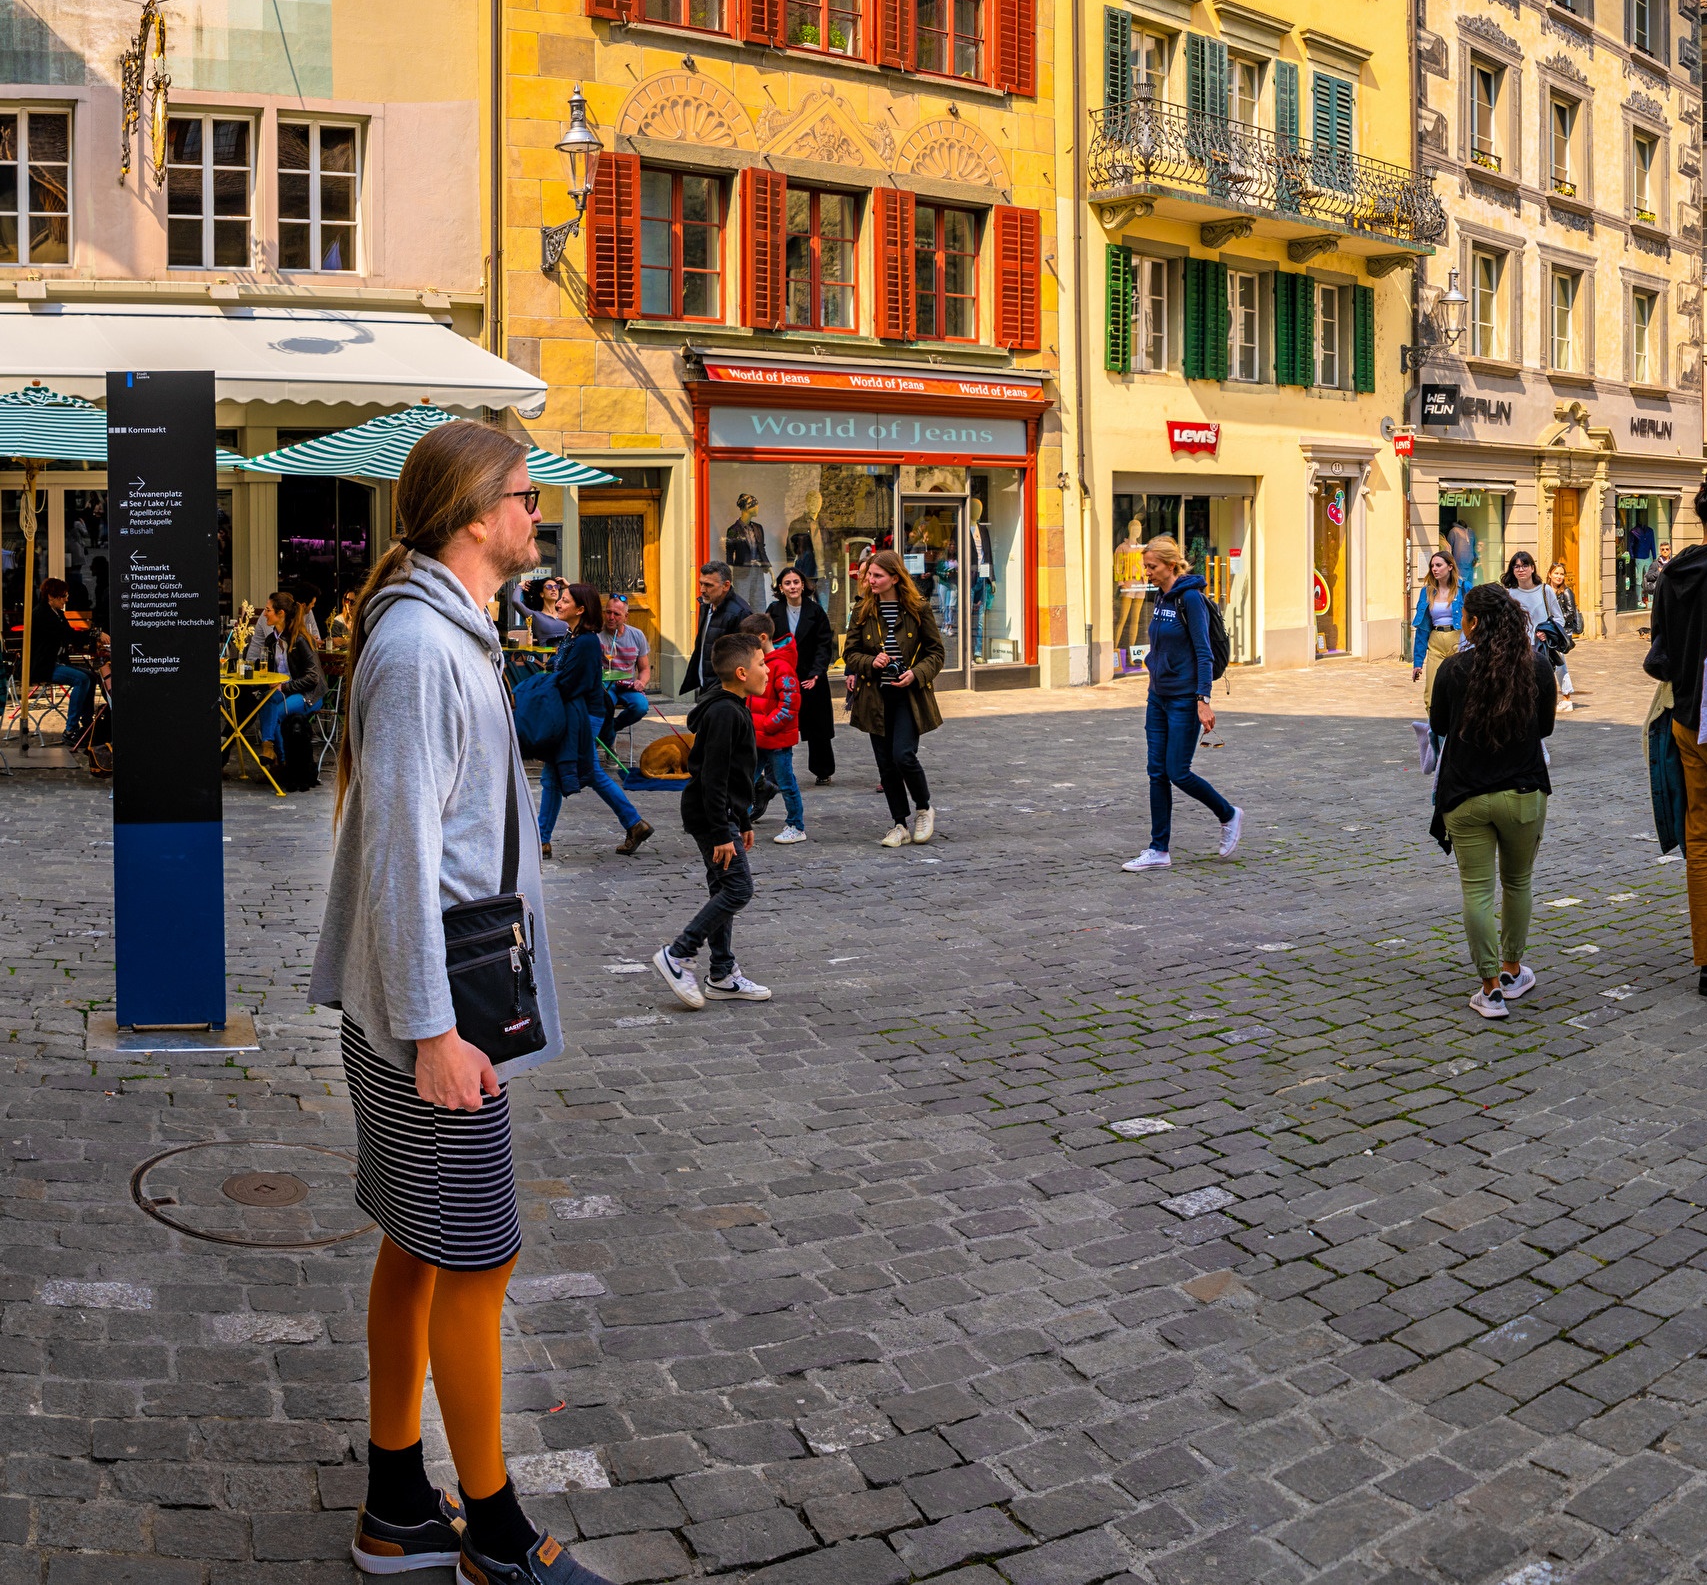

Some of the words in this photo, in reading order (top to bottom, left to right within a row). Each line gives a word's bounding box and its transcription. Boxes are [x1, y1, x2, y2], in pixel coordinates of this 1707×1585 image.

[728, 368, 764, 382] World
[766, 372, 779, 384] of
[780, 371, 811, 385] Jeans
[849, 375, 884, 389] World
[885, 378, 897, 390] of
[897, 378, 925, 391] Jeans
[958, 383, 991, 396] World
[991, 385, 1002, 397] of
[1002, 385, 1029, 398] Jeans
[128, 426, 167, 434] Kornmarkt
[750, 414, 857, 439] World
[868, 420, 902, 440] of
[910, 421, 994, 446] Jeans
[128, 490, 182, 498] Schwanenplatz
[129, 509, 172, 518] Kapellbrücke
[129, 518, 173, 527] Peterskapelle
[130, 564, 170, 572] Weinmarkt
[130, 573, 176, 582] Theaterplatz
[159, 582, 183, 590] Gütsch
[170, 591, 199, 599] Museum
[130, 601, 177, 609] Naturmuseum
[131, 610, 178, 619] Spreuerbrücke
[131, 620, 176, 628] Pädagogische
[177, 618, 215, 626] Hochschule
[132, 657, 180, 665] Hirschenplatz
[132, 666, 179, 674] Museggmauer
